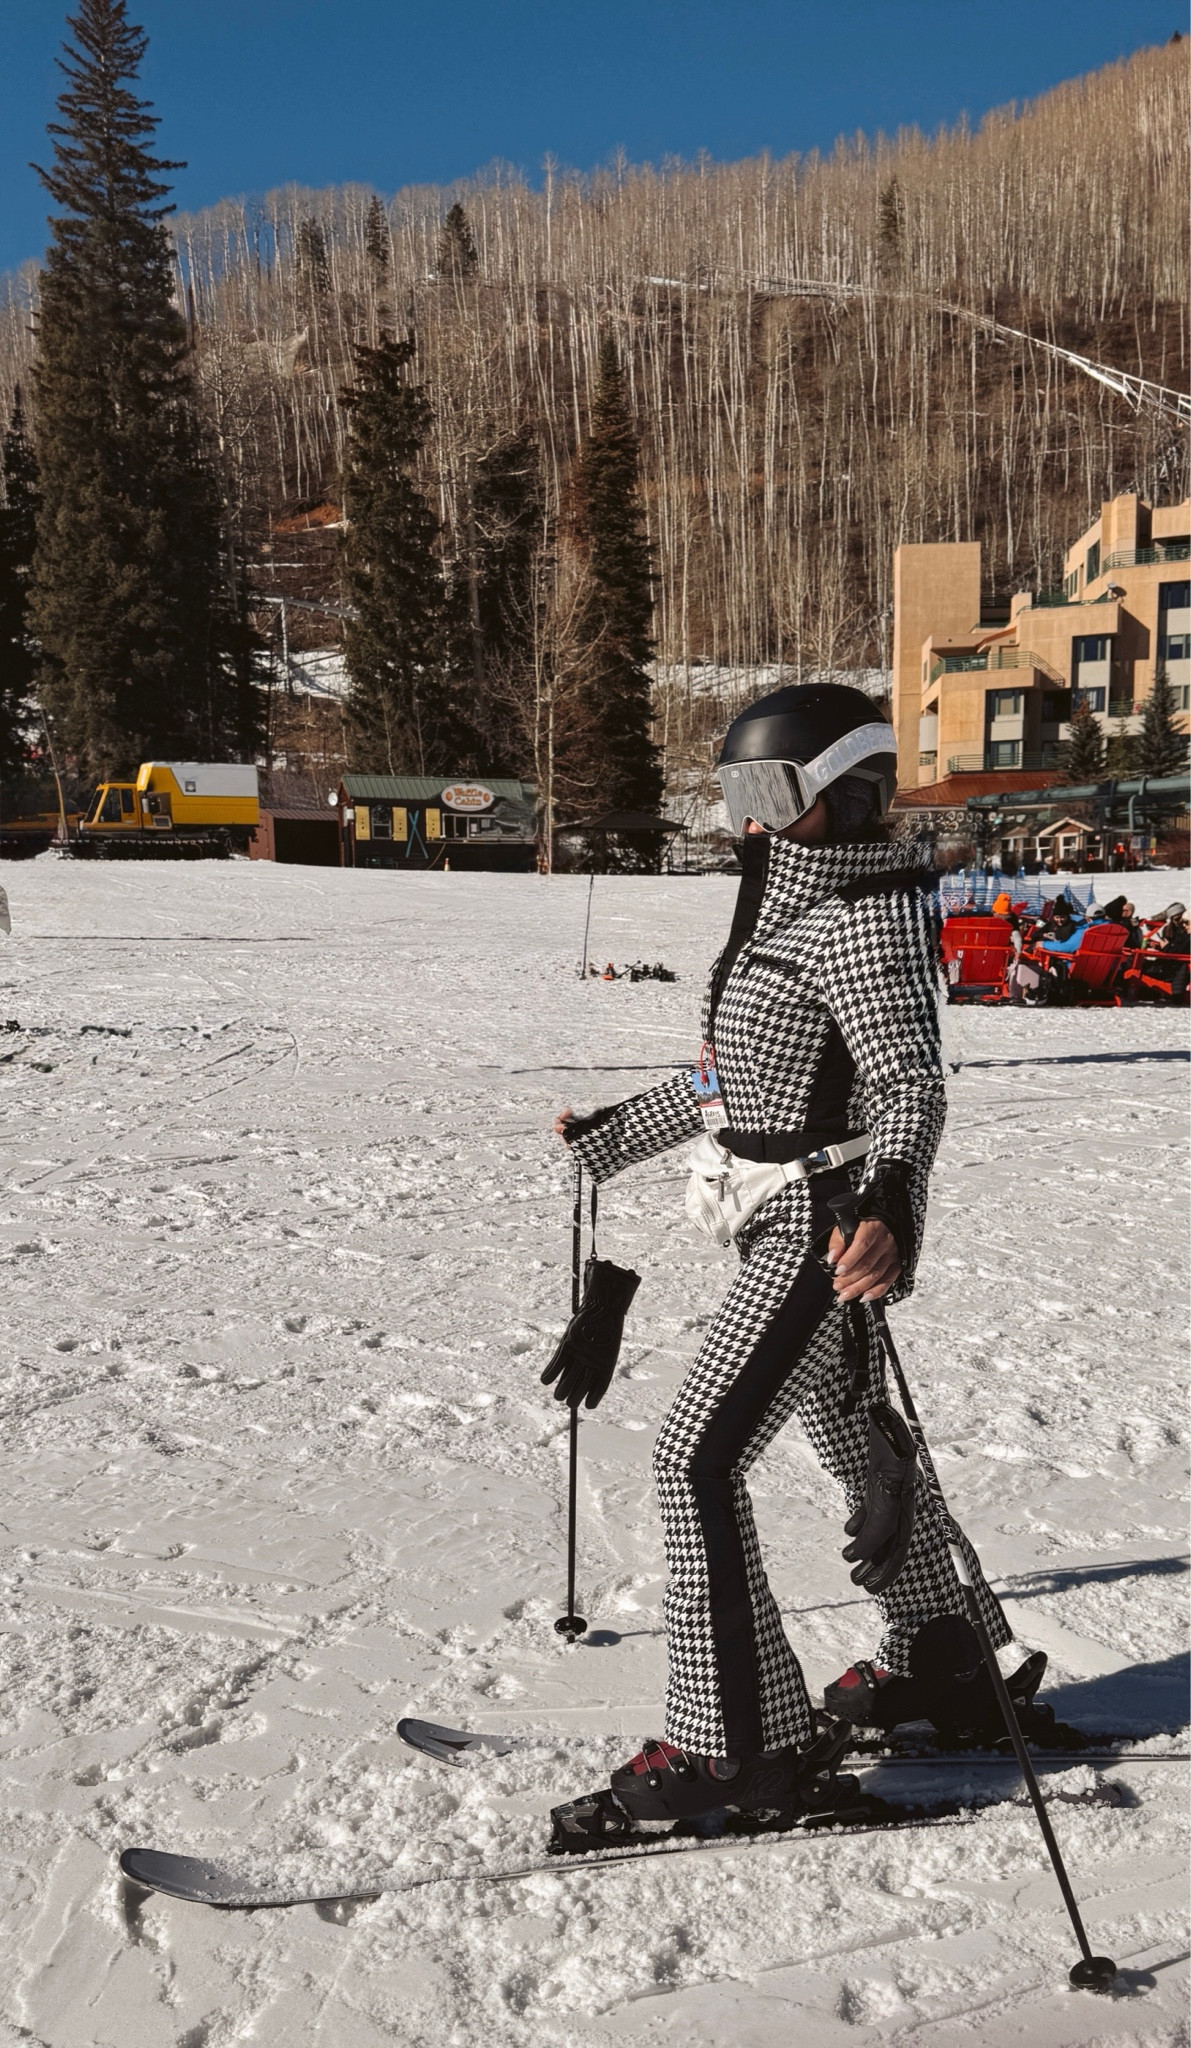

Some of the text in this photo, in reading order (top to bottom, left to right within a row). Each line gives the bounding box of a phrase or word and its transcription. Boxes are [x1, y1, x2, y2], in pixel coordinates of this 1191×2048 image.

[453, 787, 483, 797] Waffle
[454, 796, 482, 806] Cabin
[913, 1432, 956, 1540] CARBON RACER
[740, 1767, 785, 1804] K2
